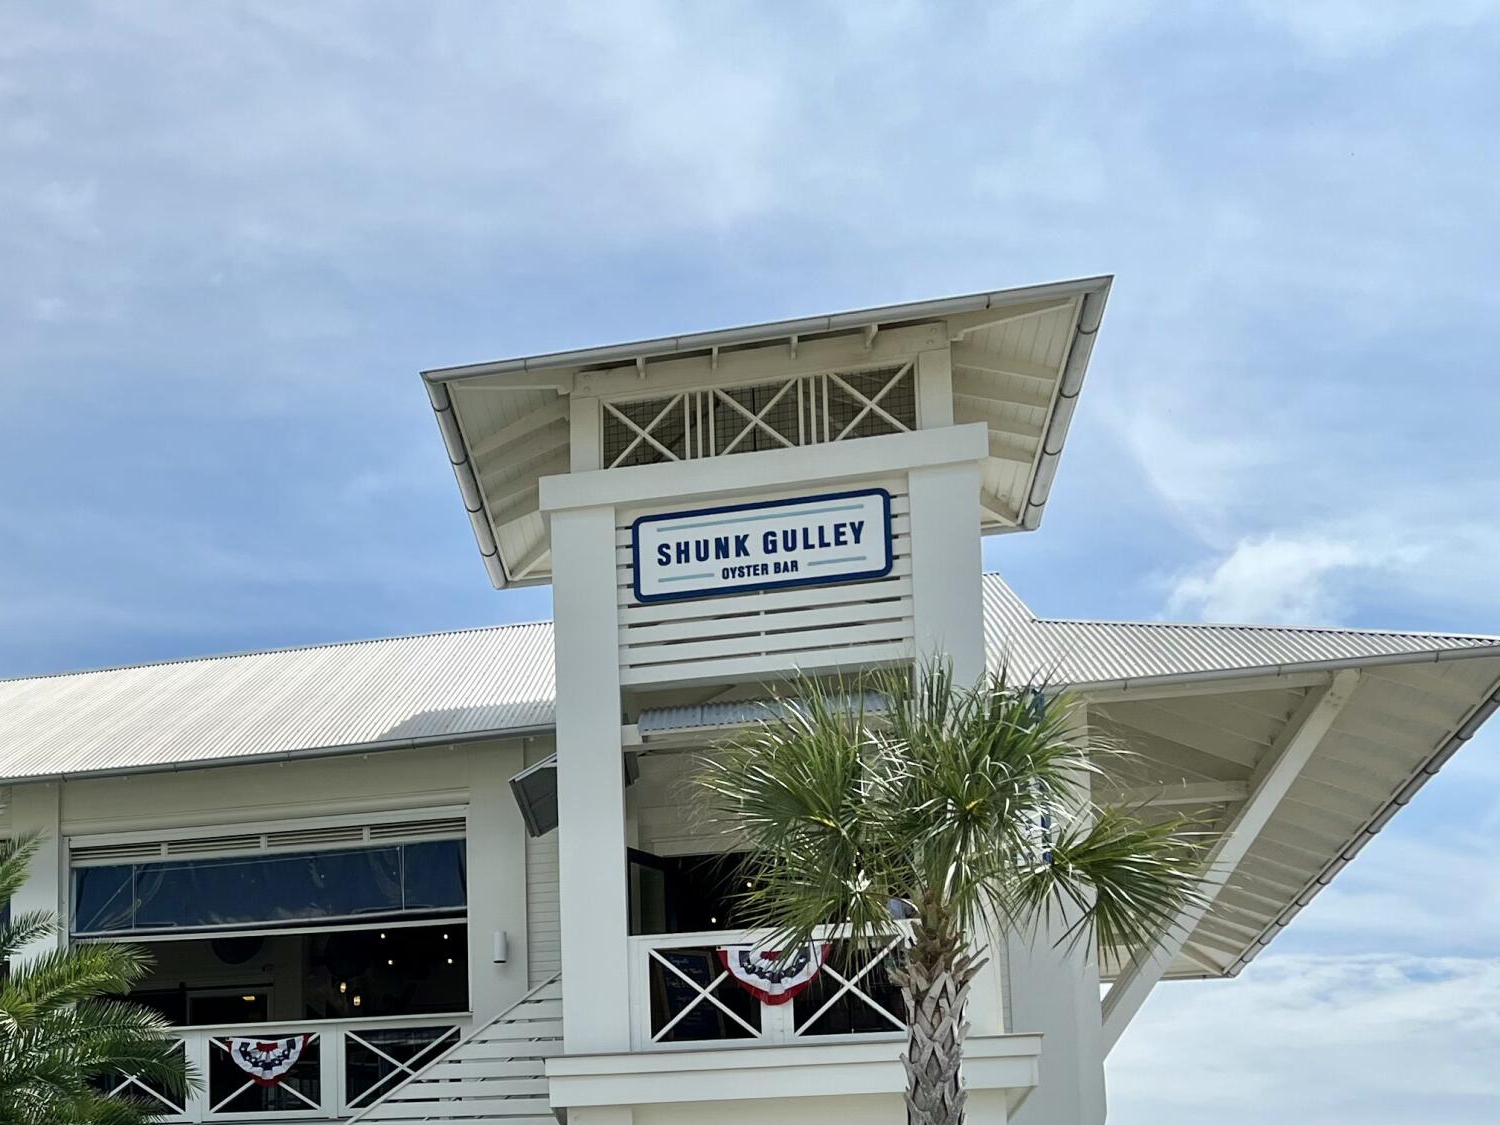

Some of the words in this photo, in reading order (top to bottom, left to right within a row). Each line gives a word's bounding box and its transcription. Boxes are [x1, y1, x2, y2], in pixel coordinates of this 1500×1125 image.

[657, 534, 750, 566] SHUNK
[762, 520, 865, 555] GULLEY
[721, 563, 769, 580] OYSTER
[773, 560, 799, 574] BAR
